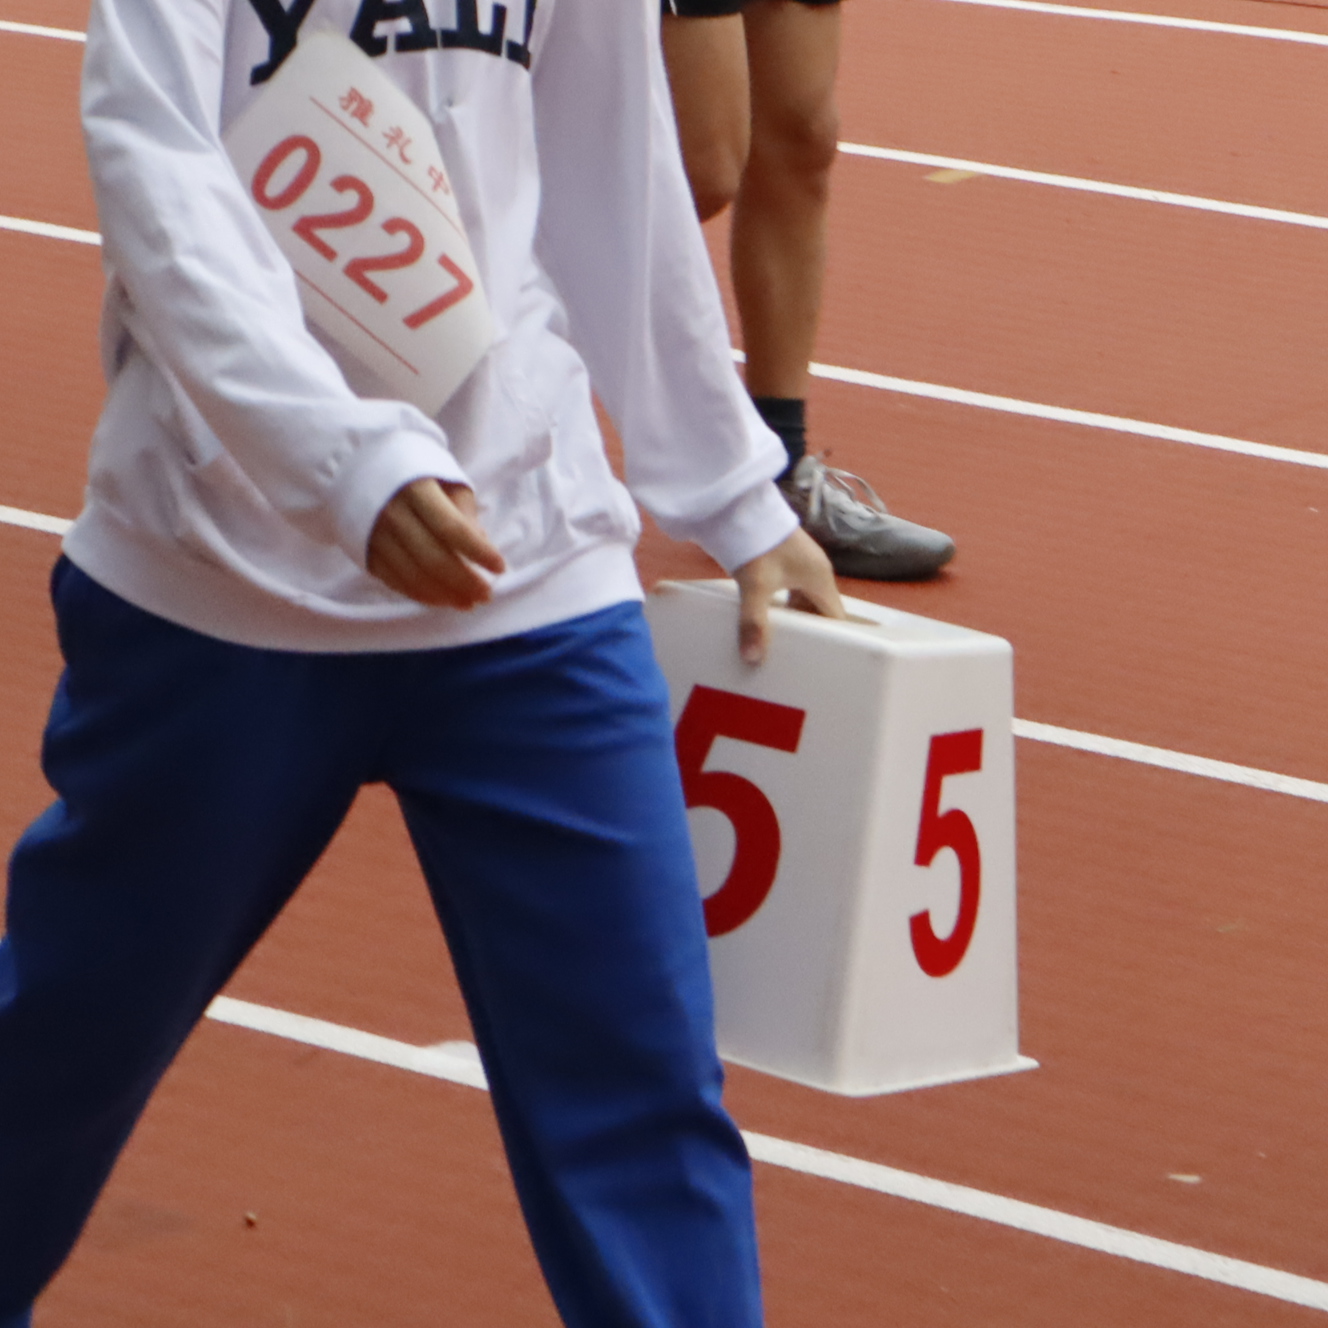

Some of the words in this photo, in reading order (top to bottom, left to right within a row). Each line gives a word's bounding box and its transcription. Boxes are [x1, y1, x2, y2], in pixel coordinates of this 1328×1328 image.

[250, 133, 475, 331] 0227
[674, 683, 807, 939] 5
[908, 727, 984, 978] 5
